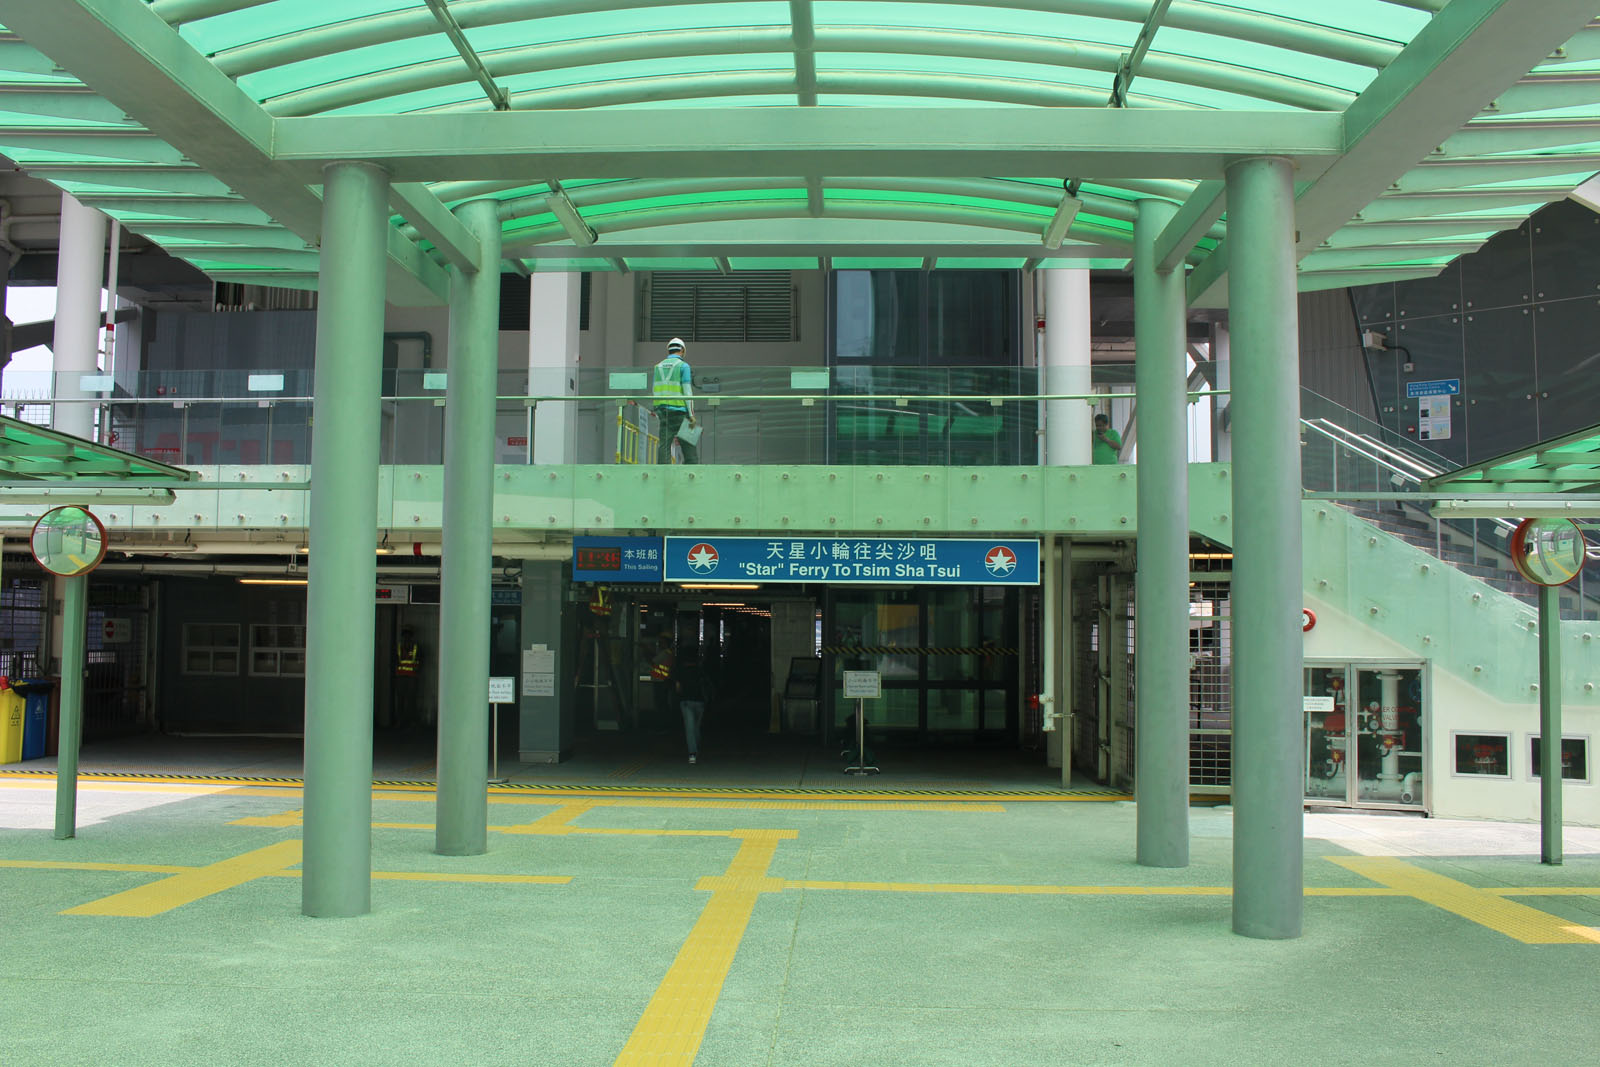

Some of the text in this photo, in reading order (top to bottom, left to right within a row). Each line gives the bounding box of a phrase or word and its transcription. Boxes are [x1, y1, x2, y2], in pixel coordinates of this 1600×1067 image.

[624, 549, 658, 560] 本班船
[766, 542, 938, 561] 天星小輪往尖沙咀
[638, 563, 658, 572] Sailing
[738, 562, 961, 579] "Star" Ferry To Tsim Sha Tsui
